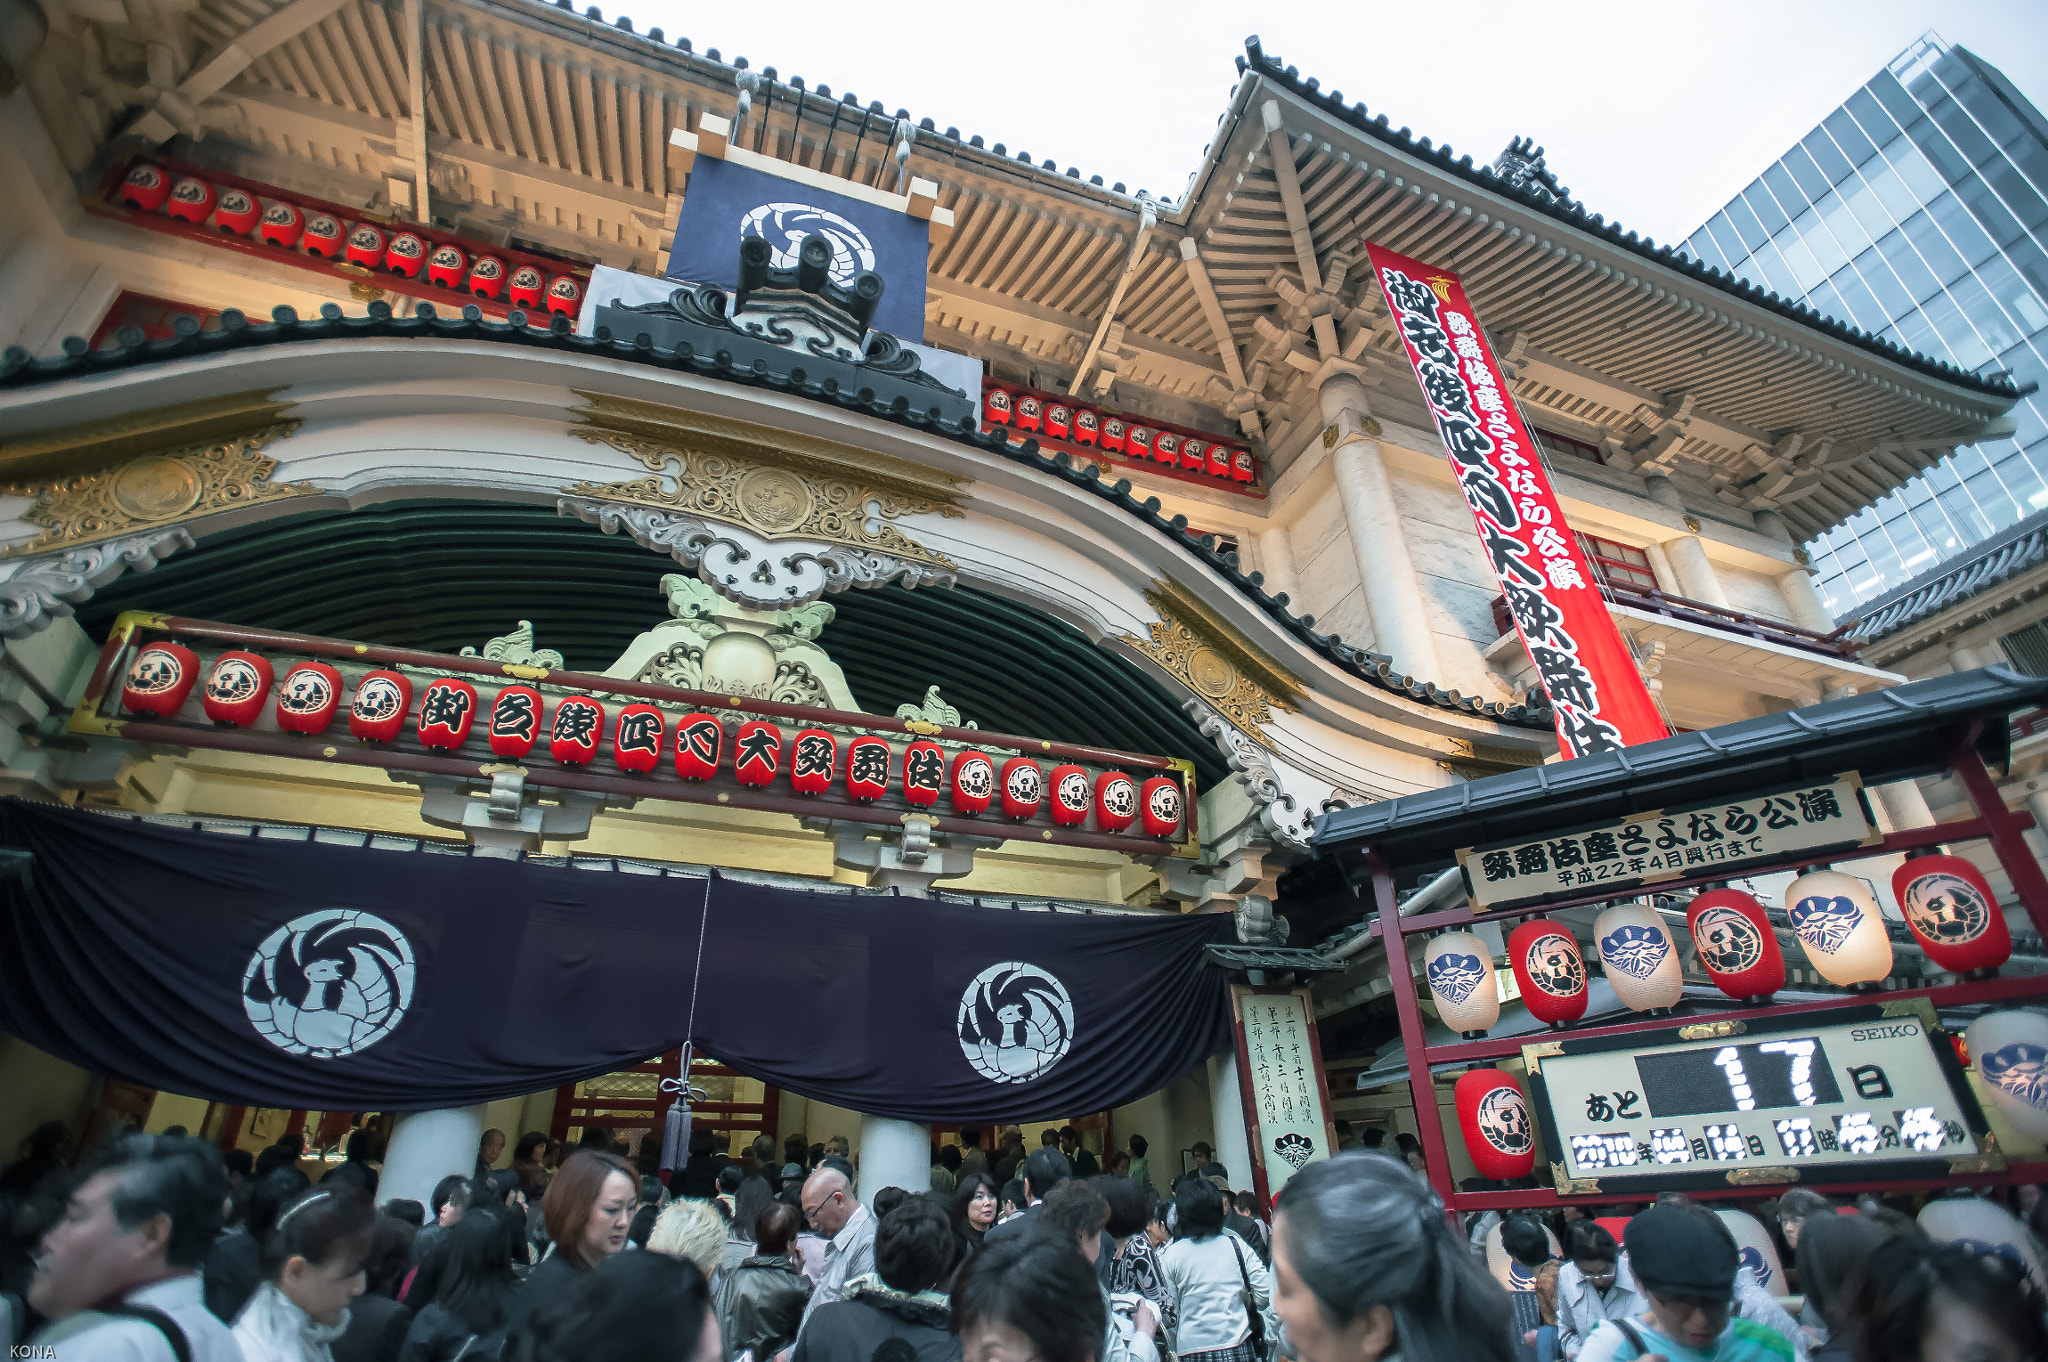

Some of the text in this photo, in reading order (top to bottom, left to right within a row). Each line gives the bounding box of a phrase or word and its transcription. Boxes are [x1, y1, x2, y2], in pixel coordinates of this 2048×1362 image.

[1444, 310, 1587, 591] 歌舞伎座さよなら公演
[1481, 788, 1842, 881] 歌舞伎座さよなら公演
[1557, 835, 1765, 887] 平成22年4月興行まで
[1850, 1024, 1919, 1043] SEIKO
[1585, 1038, 1894, 1123] あと 17 日
